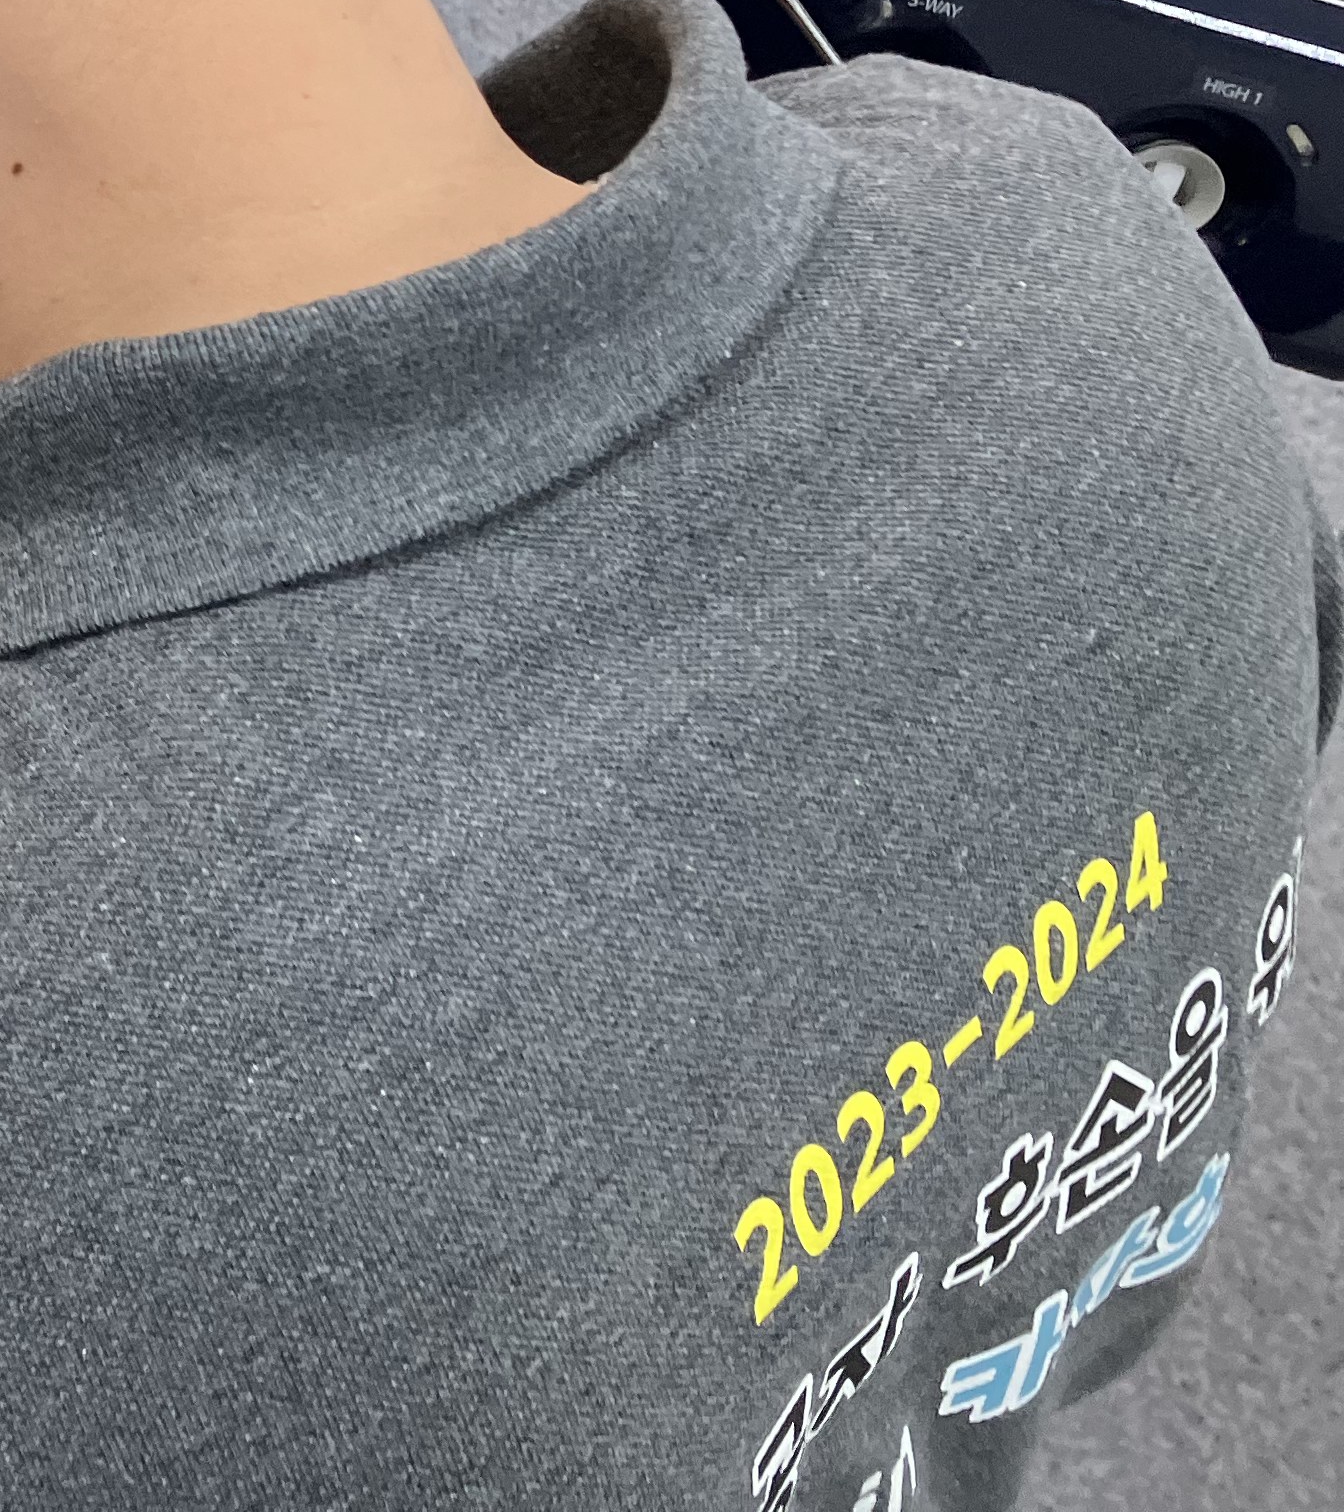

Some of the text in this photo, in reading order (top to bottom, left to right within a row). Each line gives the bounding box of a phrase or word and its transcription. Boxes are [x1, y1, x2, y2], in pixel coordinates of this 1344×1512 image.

[1202, 76, 1264, 107] HIGH 1
[734, 810, 1169, 1326] 2023-2024
[941, 967, 1230, 1290] 후손을
